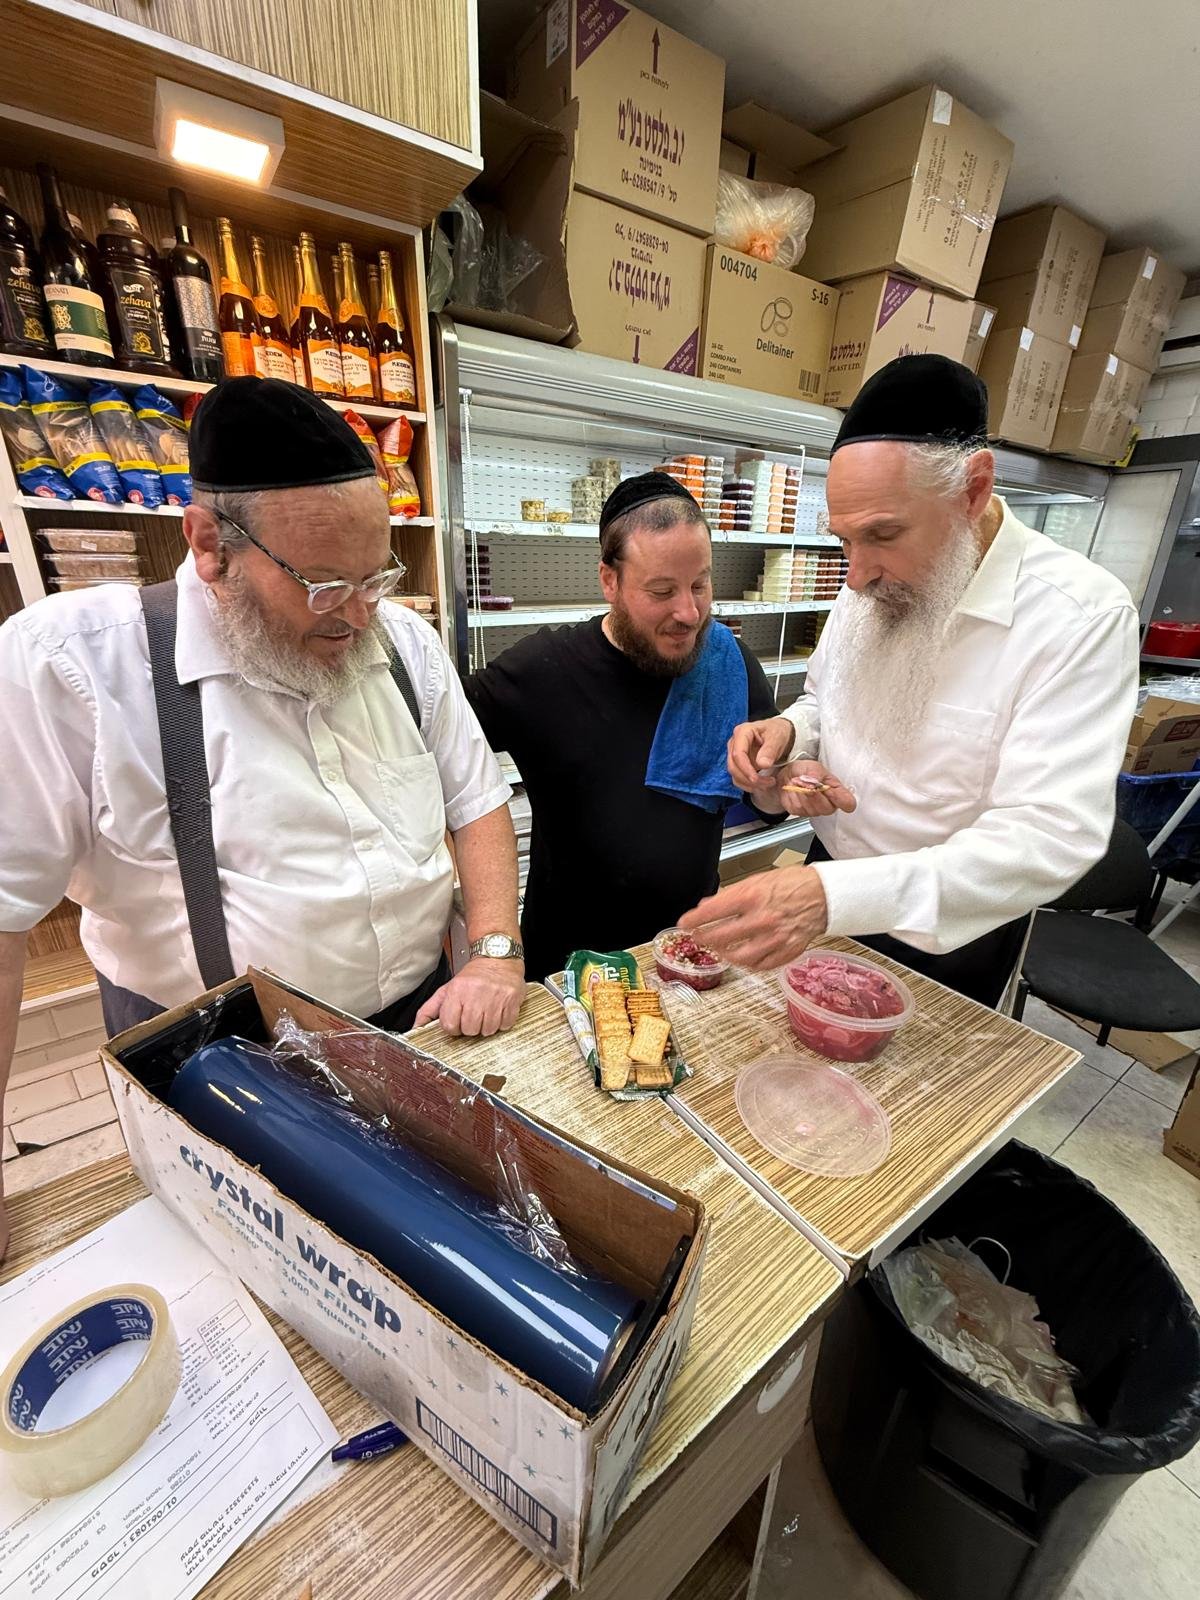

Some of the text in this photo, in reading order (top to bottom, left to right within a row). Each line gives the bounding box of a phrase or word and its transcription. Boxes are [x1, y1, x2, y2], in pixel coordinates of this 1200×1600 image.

[720, 255, 758, 281] 004704
[120, 294, 151, 309] zehava
[811, 288, 829, 306] S-16
[710, 352, 737, 363] COMBO PACK
[756, 338, 794, 359] Delitainer
[179, 1145, 401, 1333] crystal wrap
[217, 1198, 367, 1329] Foodservice Film
[282, 1268, 387, 1360] 3,000 Square Feet
[91, 1551, 120, 1578] מספר
[129, 1496, 177, 1543] 01/061083
[180, 1476, 260, 1563] עוסק מורשה 515353522
[186, 1555, 205, 1576] תודה
[207, 1526, 233, 1556] שרכשת
[234, 1517, 242, 1526] בן
[242, 1503, 254, 1517] אלי
[268, 1469, 288, 1489] איכות
[288, 1447, 309, 1471] ושירות
[202, 1522, 226, 1549] תחרות
